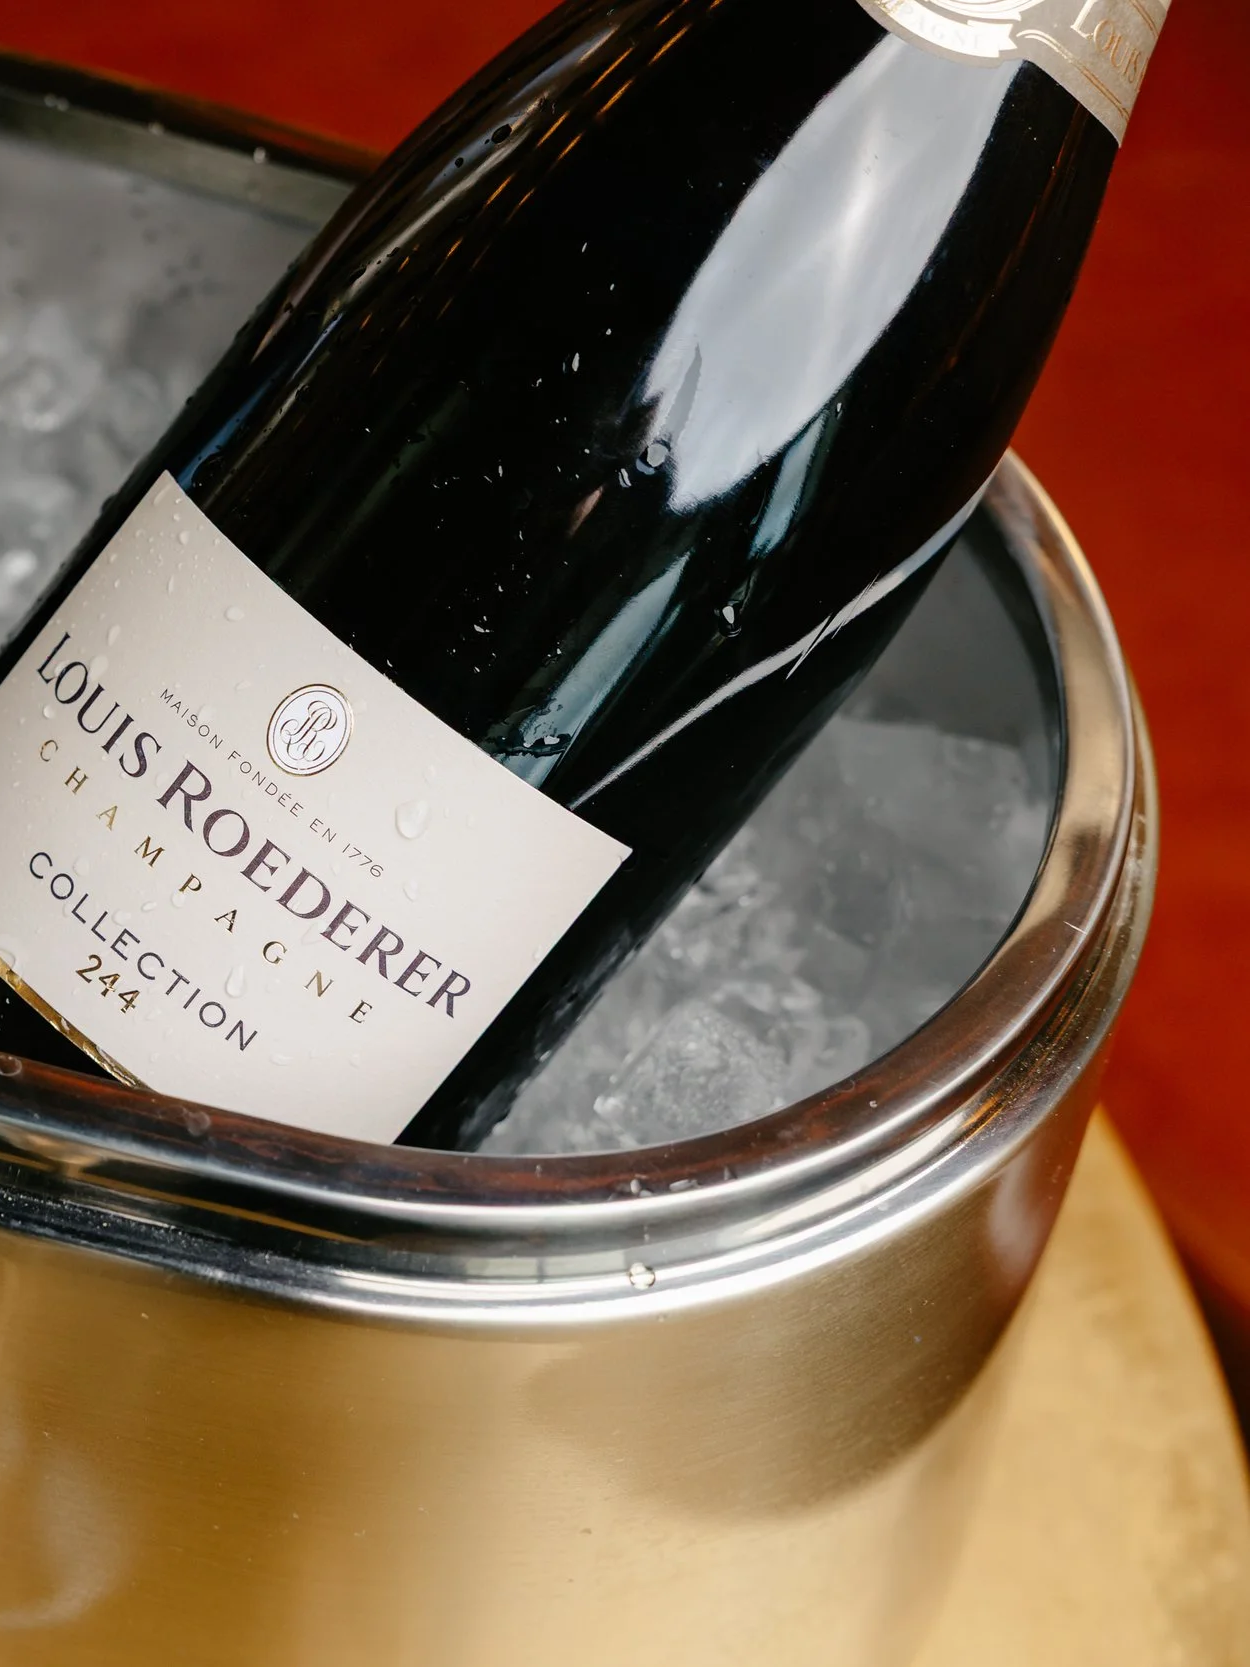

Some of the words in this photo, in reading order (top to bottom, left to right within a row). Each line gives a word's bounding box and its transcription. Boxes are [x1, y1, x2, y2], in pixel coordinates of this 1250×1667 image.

[37, 632, 162, 778] LOUIS
[155, 760, 472, 1021] ROEDERER
[39, 739, 371, 1026] CHAMPAGNE
[159, 688, 225, 750] MAISON
[227, 750, 305, 818] FONDÉE
[309, 818, 338, 844] EN
[341, 843, 385, 878] 1776
[29, 851, 258, 1053] COLLECTION
[75, 954, 138, 1014] 244
